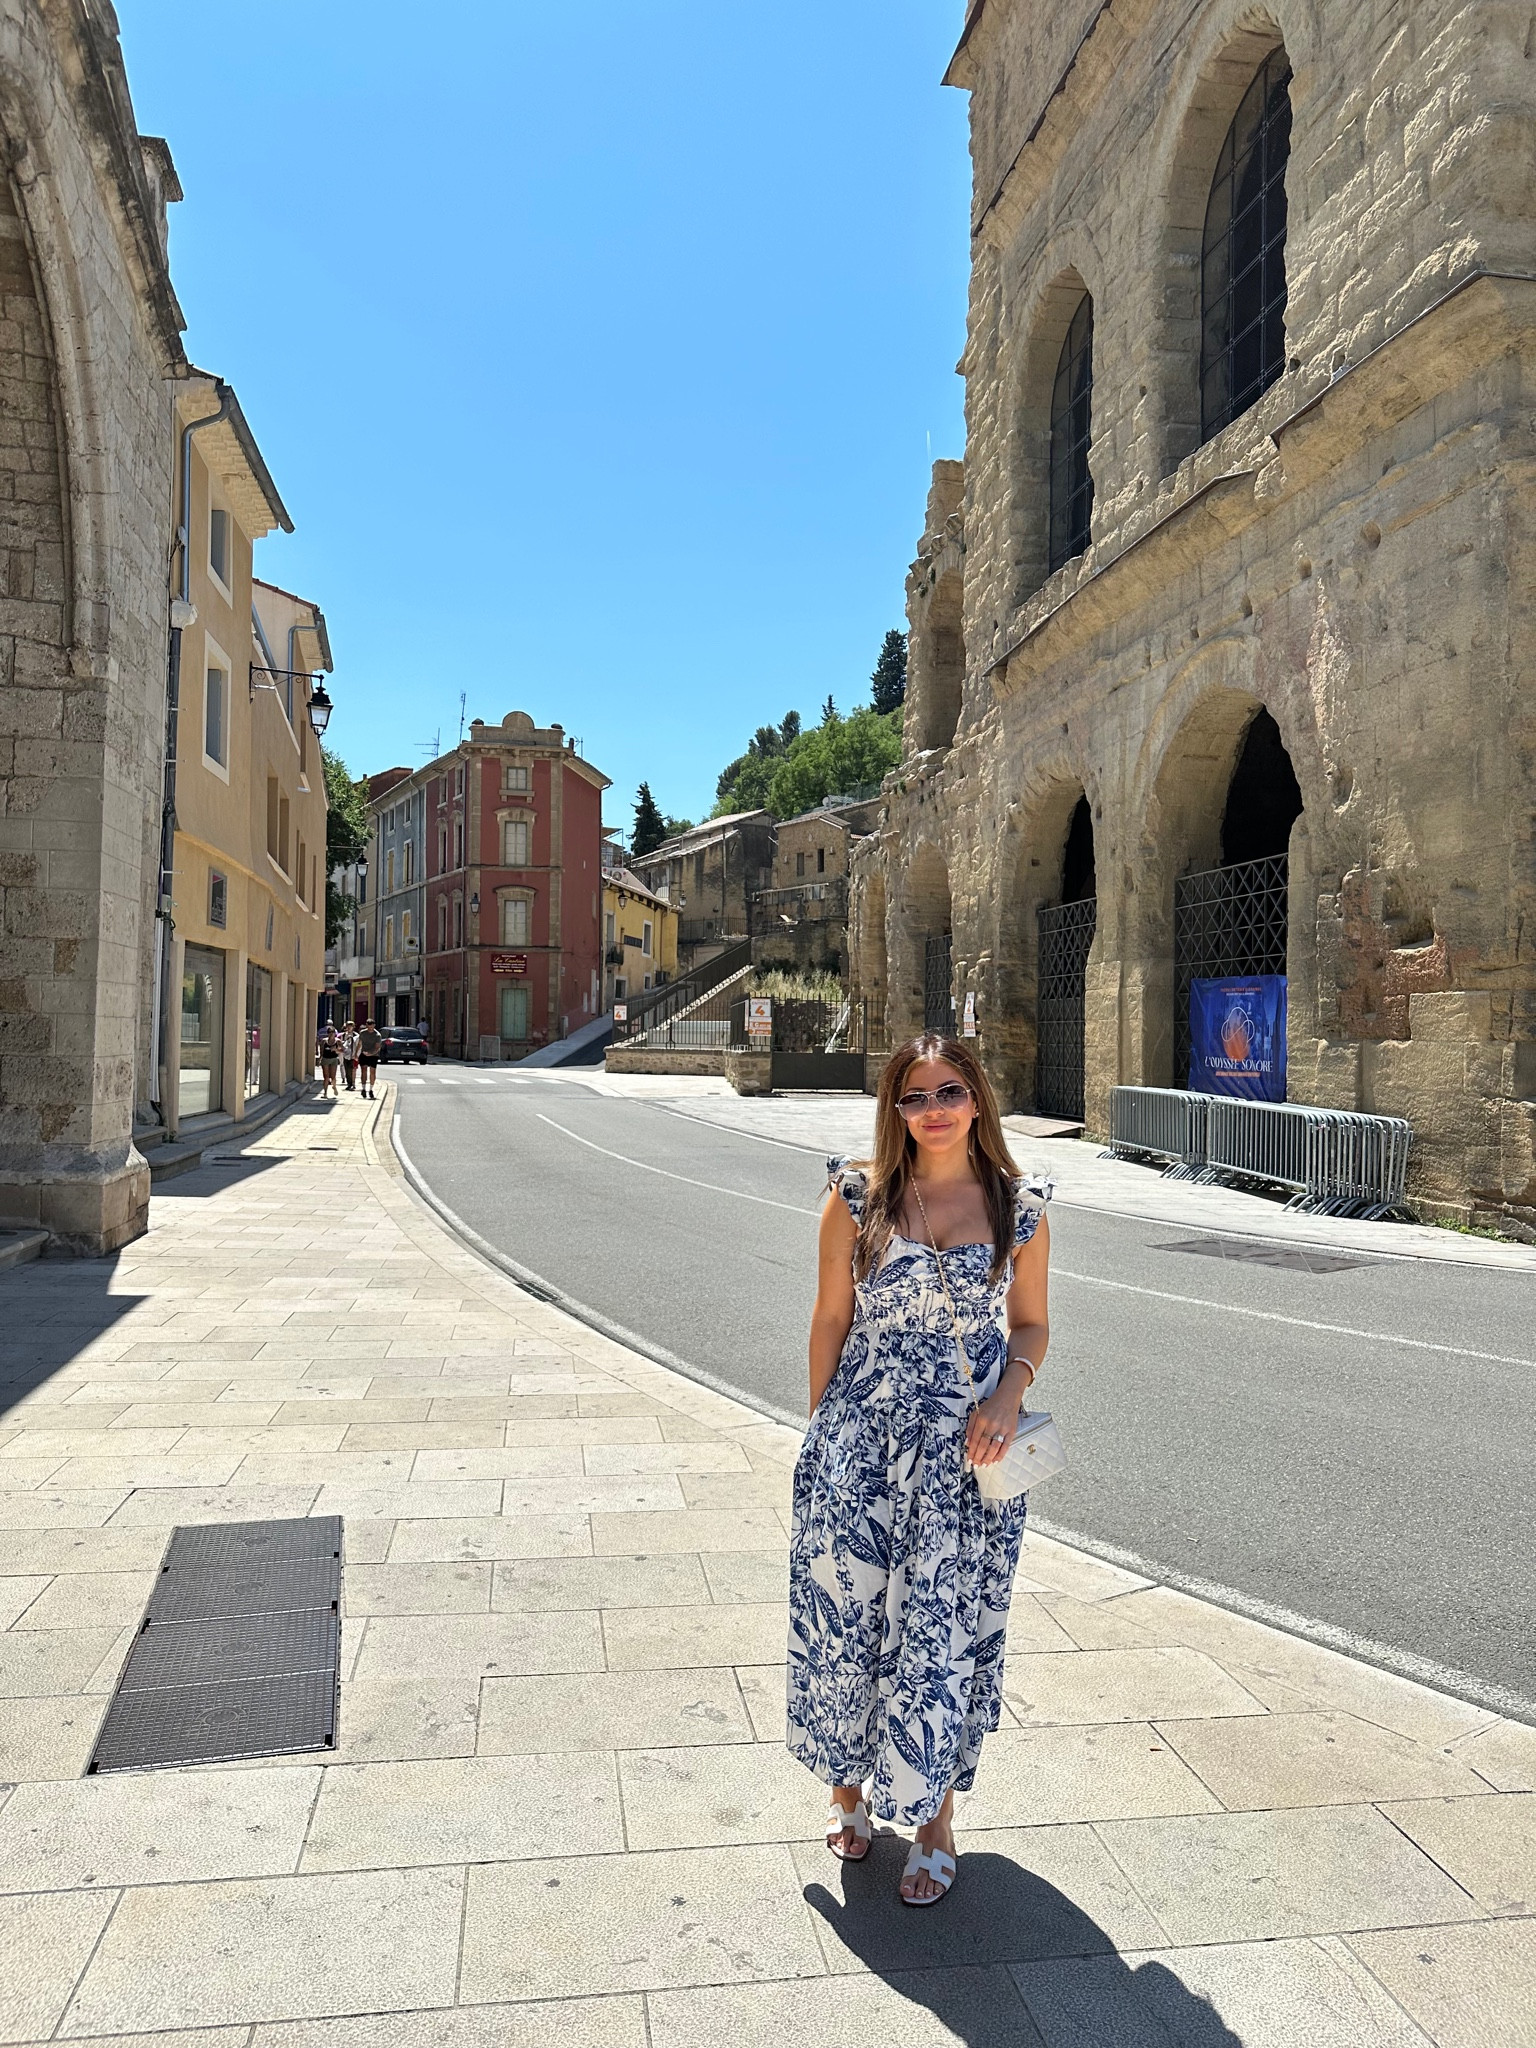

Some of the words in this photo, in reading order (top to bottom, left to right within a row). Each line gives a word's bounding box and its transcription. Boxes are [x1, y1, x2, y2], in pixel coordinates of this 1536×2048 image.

[755, 1005, 765, 1016] 4
[967, 1000, 971, 1012] 2
[1204, 1056, 1239, 1070] L'ODYSSÉE
[1241, 1058, 1273, 1073] SONORE
